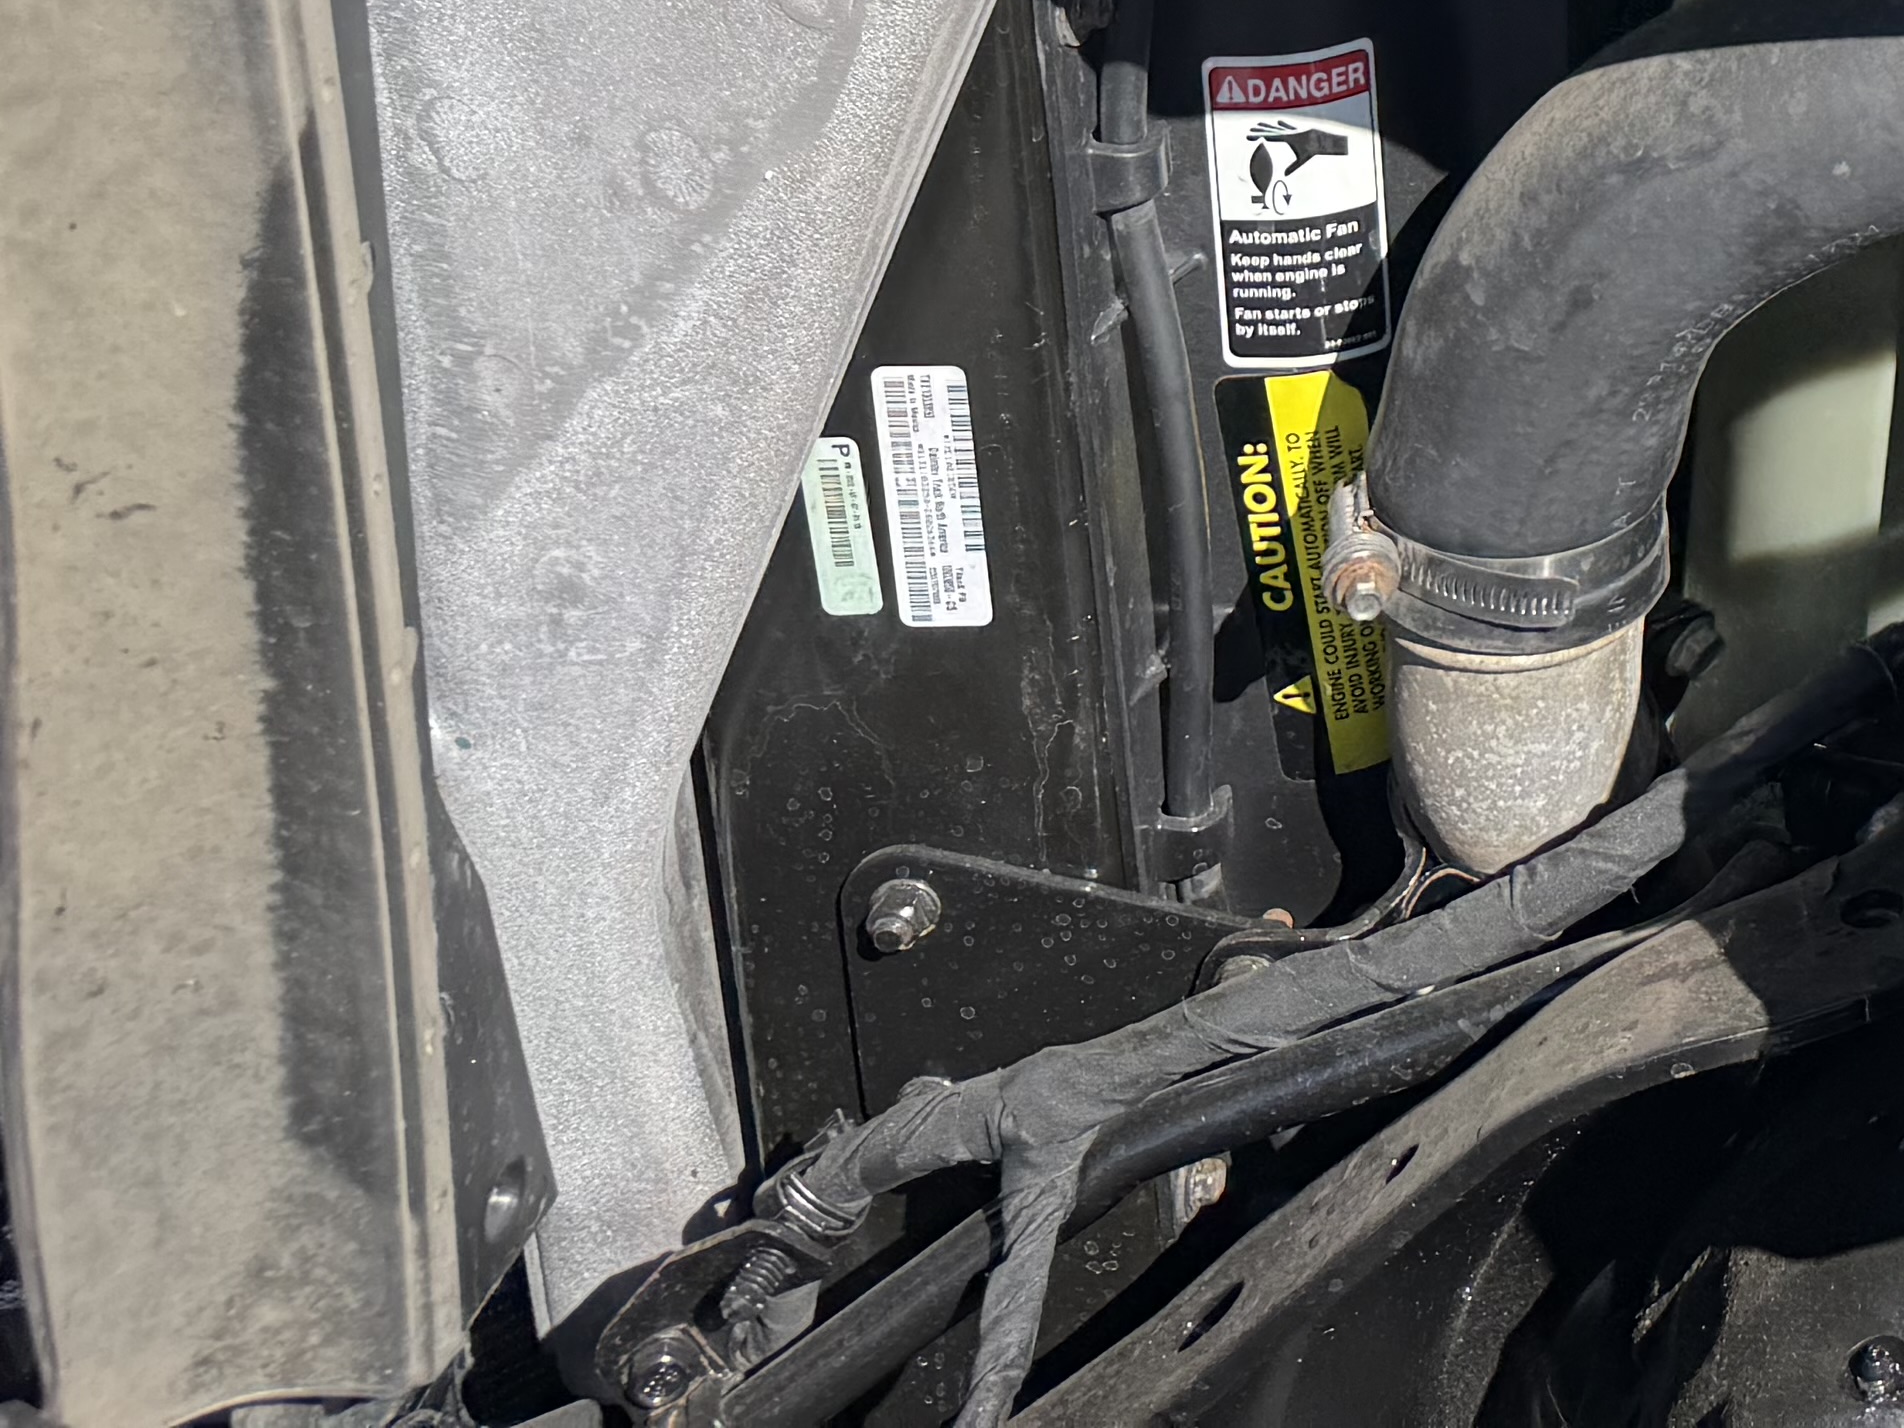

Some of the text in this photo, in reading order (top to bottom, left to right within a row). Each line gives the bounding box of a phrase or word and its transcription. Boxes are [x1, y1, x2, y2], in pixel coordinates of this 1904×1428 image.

[1247, 62, 1366, 104] DANGER
[1229, 220, 1359, 244] Automatic Fan
[1230, 243, 1363, 269] Keep hands clear
[1231, 263, 1346, 284] when engine is
[1232, 285, 1297, 301] running.
[1234, 295, 1375, 320] Fan starts or stops
[1235, 322, 1301, 338] by itself.
[831, 443, 850, 458] P
[1285, 432, 1302, 452] TO
[1313, 479, 1330, 506] OFF
[1237, 443, 1294, 611] CAUTION:
[1319, 619, 1338, 665] COULD
[1339, 622, 1369, 714] AVOID INJURY
[1362, 641, 1386, 711] WORKING
[1327, 668, 1350, 721] ENGINE
